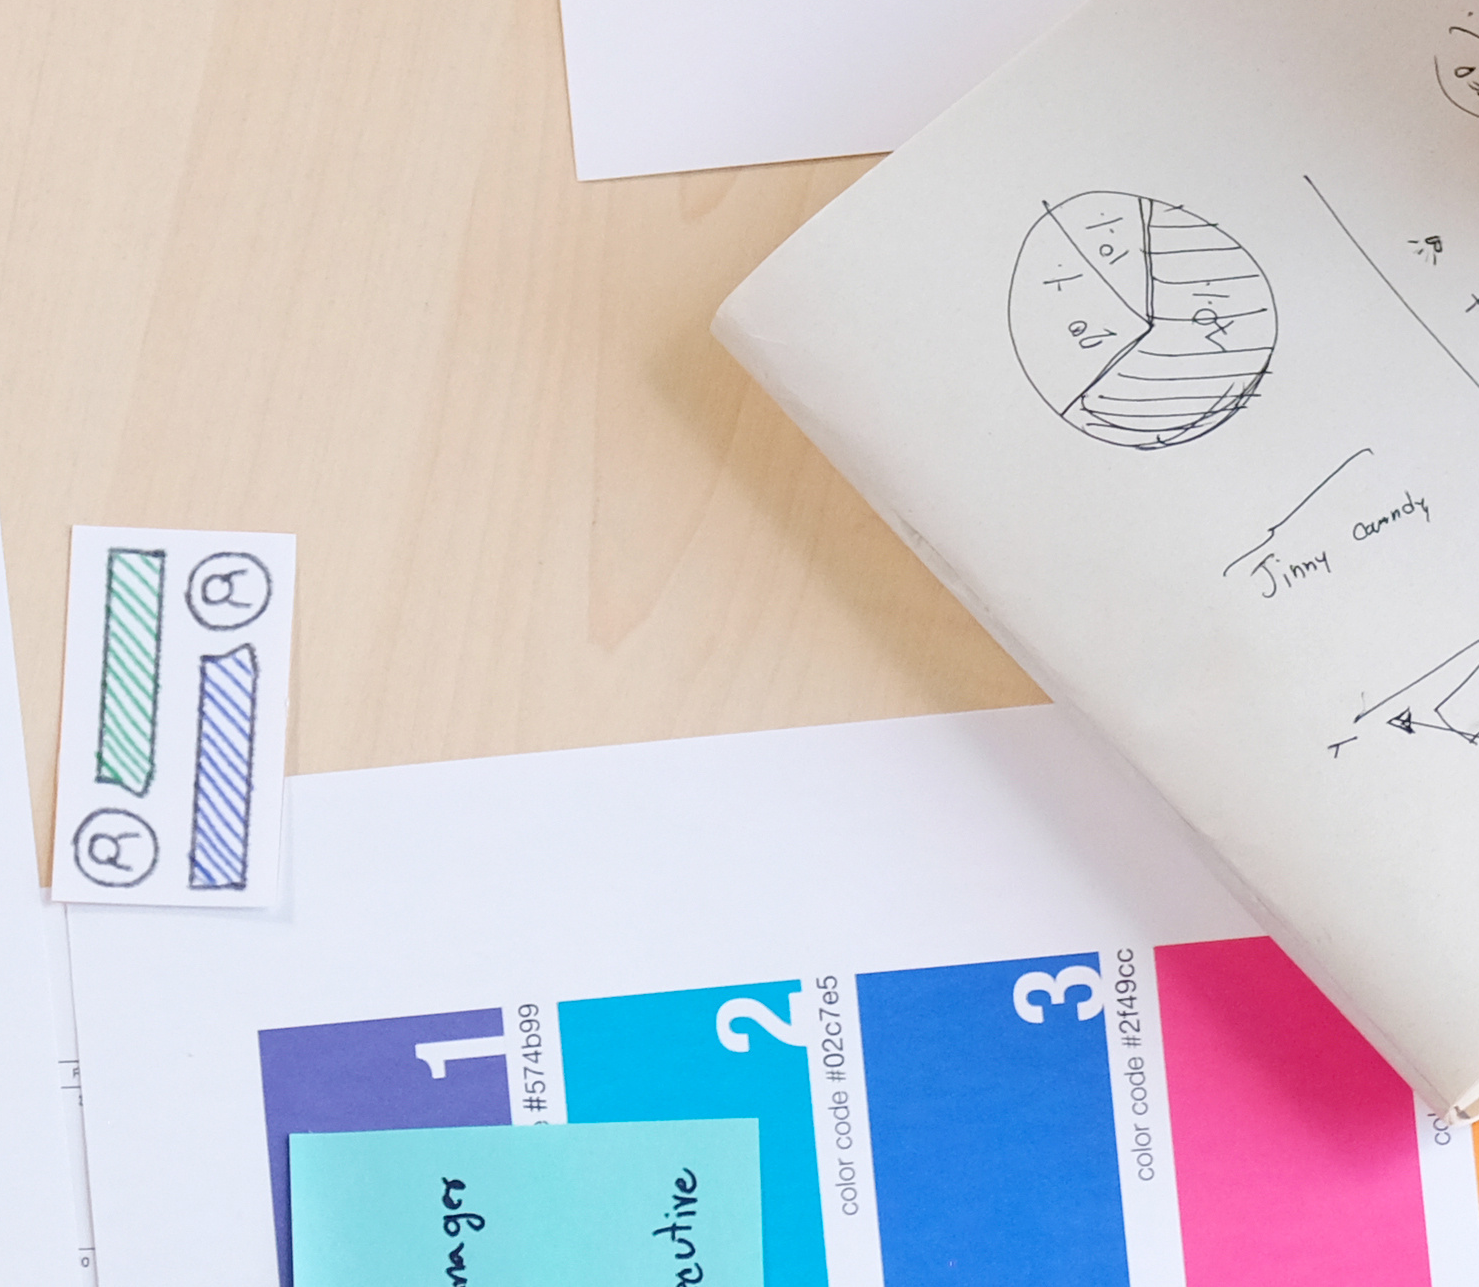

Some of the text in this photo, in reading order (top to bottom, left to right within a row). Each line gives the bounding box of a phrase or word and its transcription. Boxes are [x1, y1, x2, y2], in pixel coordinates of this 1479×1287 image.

[715, 991, 810, 1054] 2
[1012, 964, 1103, 1024] 3
[415, 1035, 506, 1079] 1
[517, 1003, 547, 1112] #574b99
[815, 974, 859, 1216] color code #02c7e5
[1116, 947, 1154, 1182] color code #2f49cc
